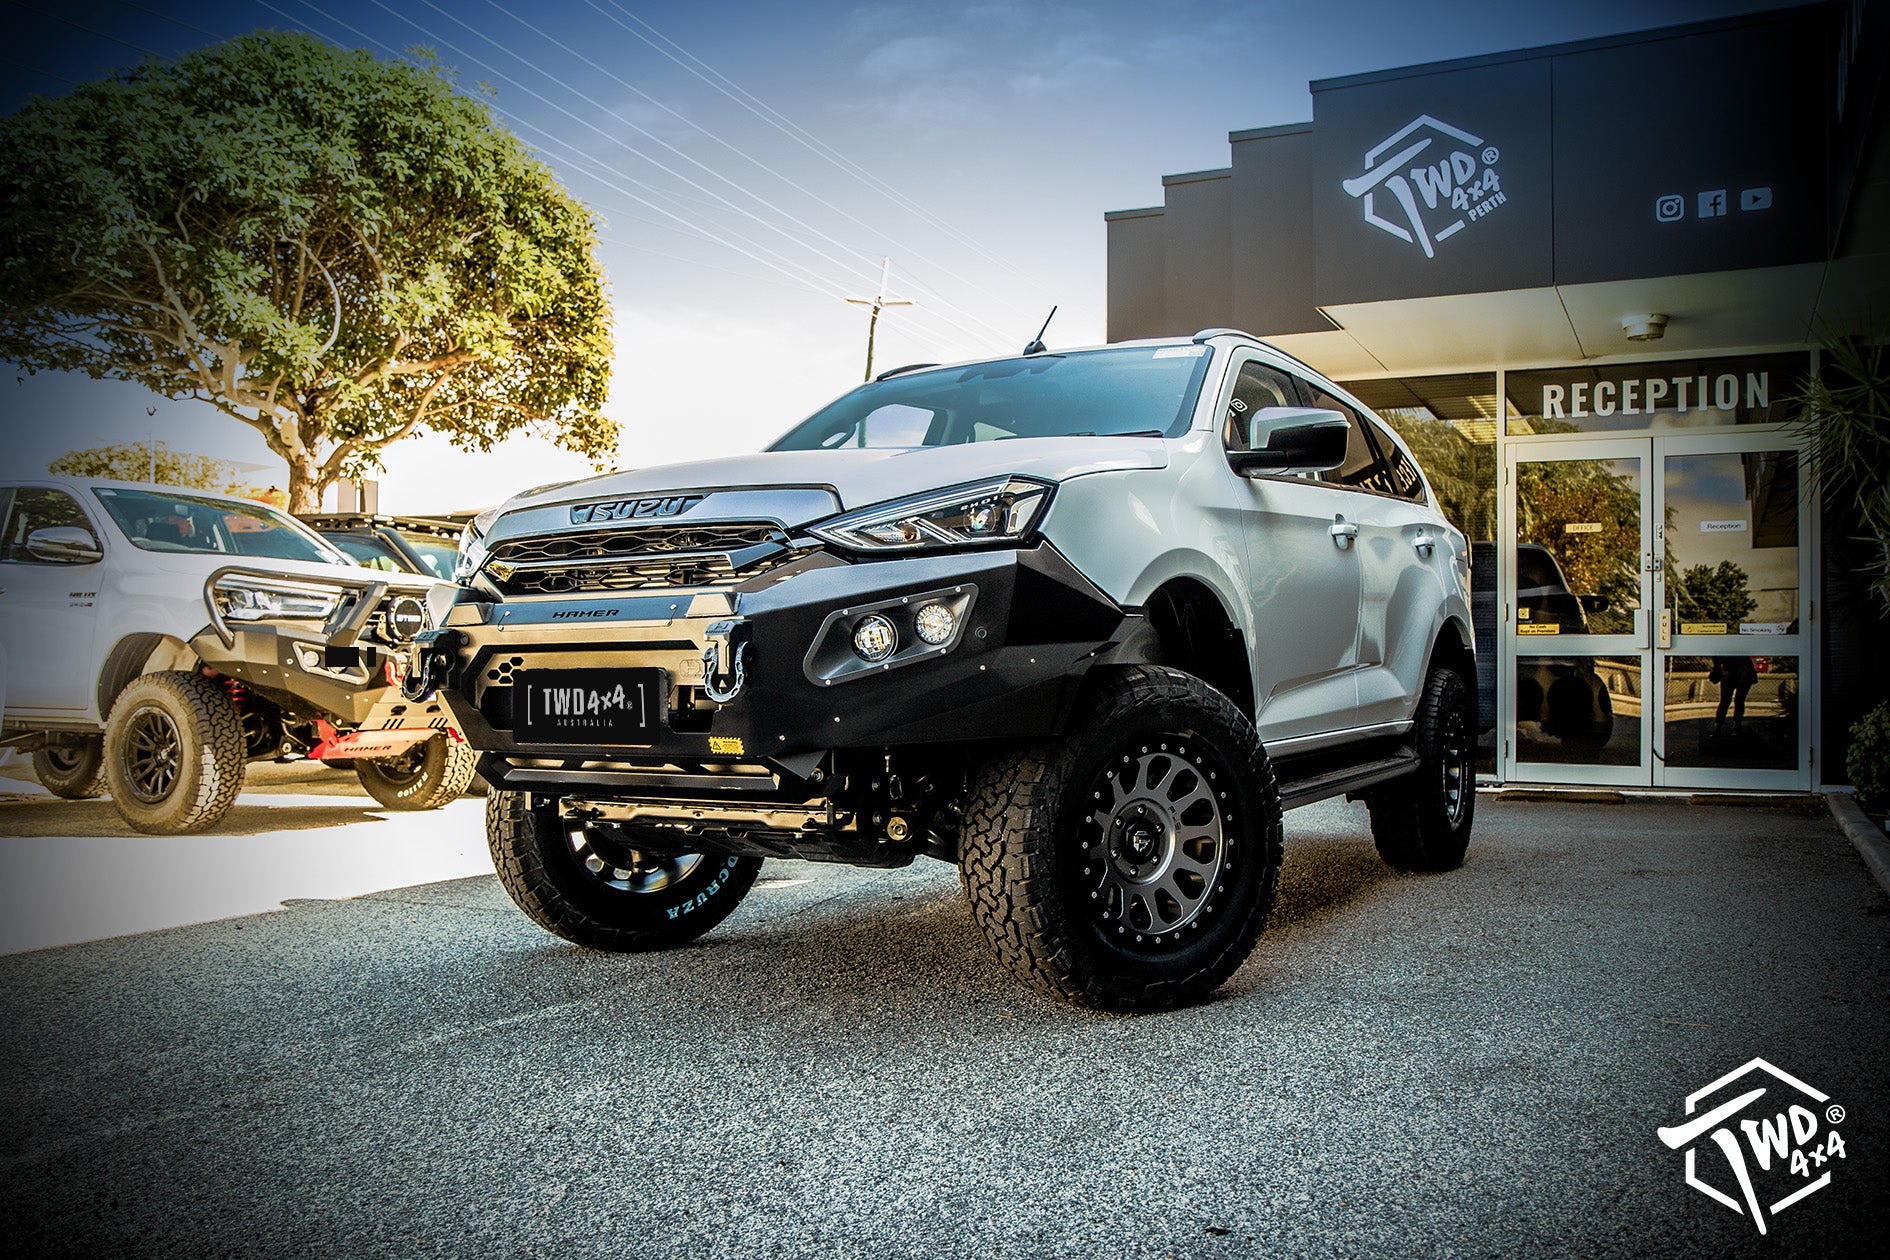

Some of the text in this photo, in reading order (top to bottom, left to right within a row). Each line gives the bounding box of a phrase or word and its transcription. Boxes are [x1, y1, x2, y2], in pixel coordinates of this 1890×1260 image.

[1468, 191, 1507, 222] PERTH
[1543, 371, 1769, 419] RECEPTION
[575, 497, 685, 523] ISUZU
[1706, 523, 1741, 531] Reception
[552, 609, 620, 618] HAMER
[556, 719, 613, 727] AUSTRALIA
[666, 855, 739, 920] DCRUZA
